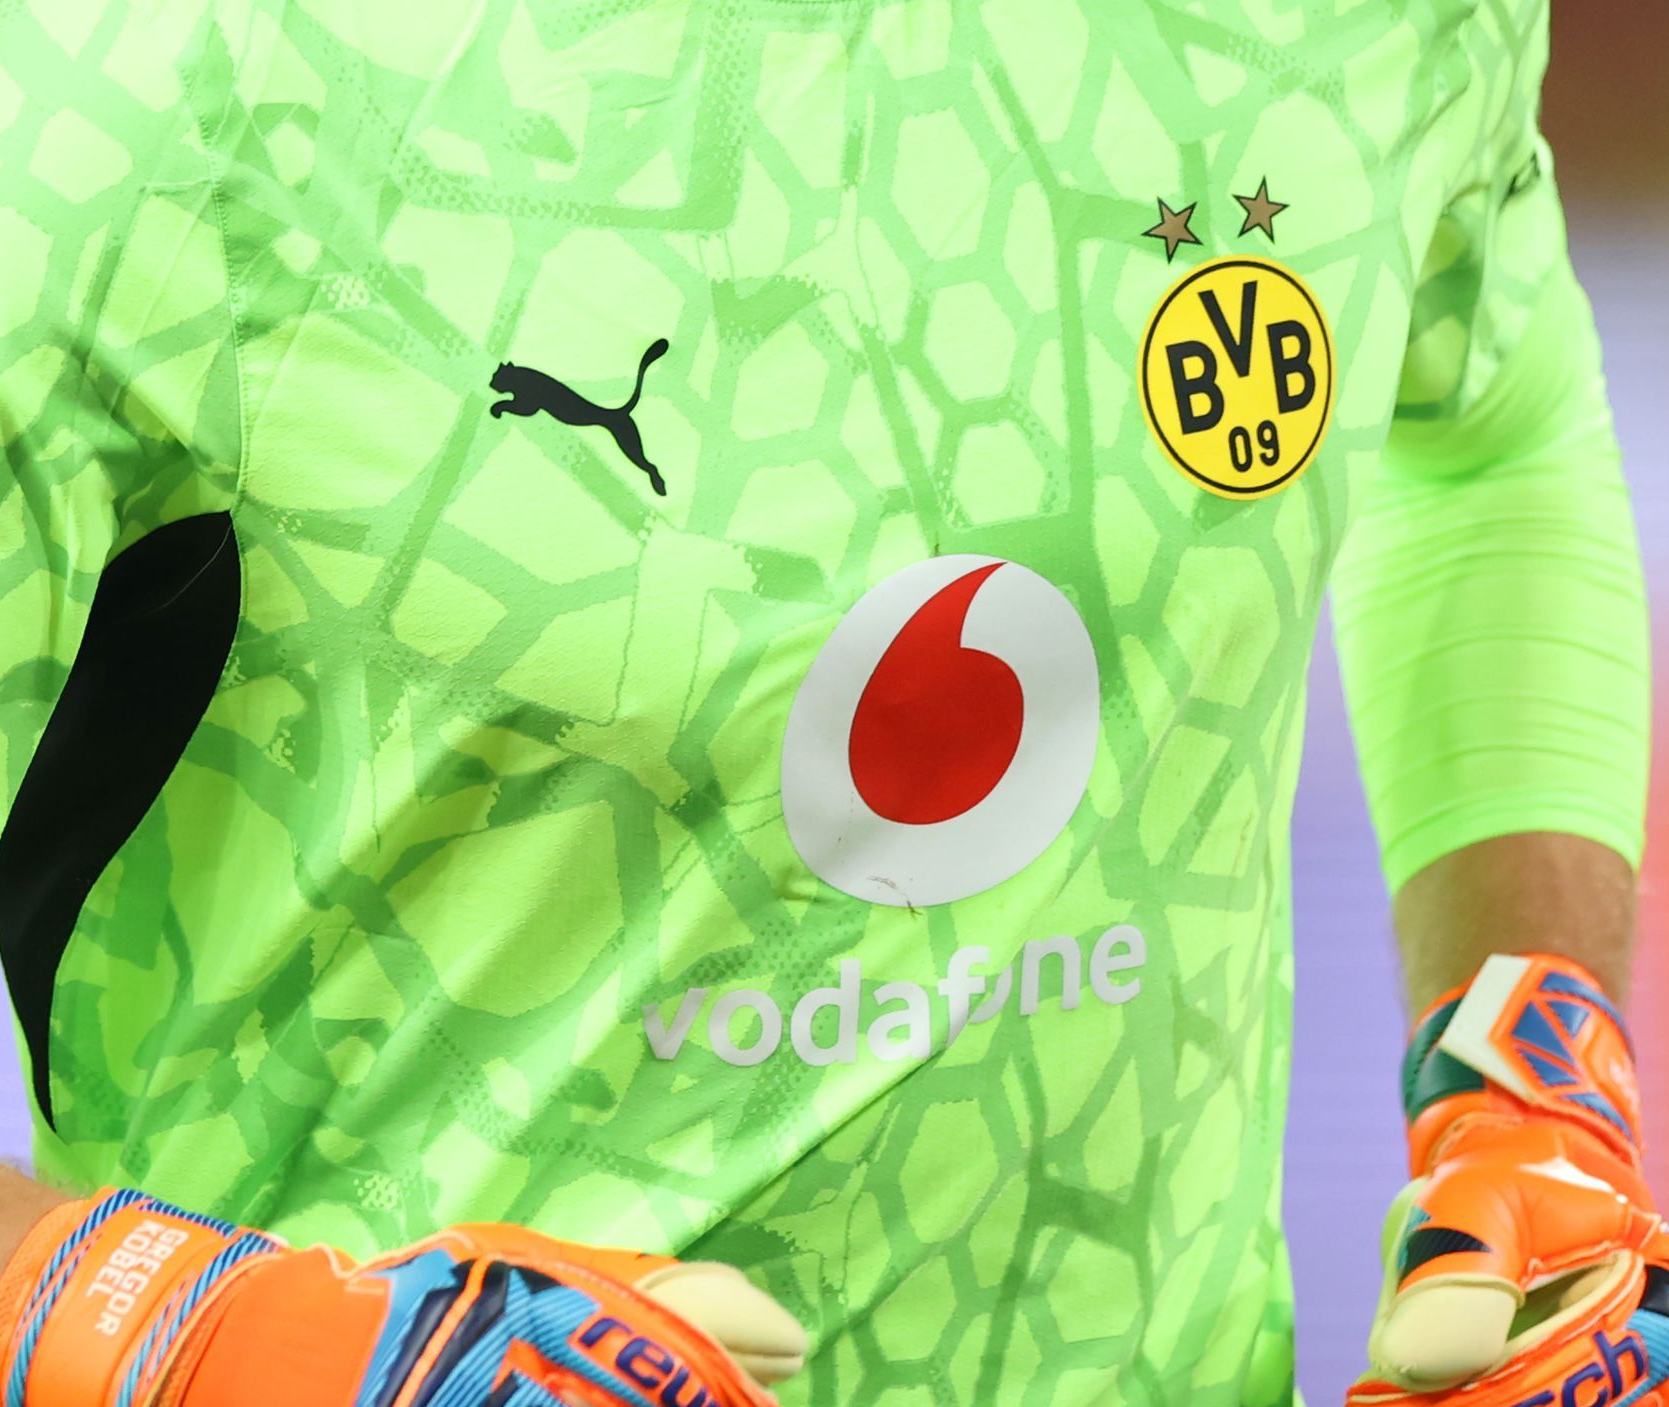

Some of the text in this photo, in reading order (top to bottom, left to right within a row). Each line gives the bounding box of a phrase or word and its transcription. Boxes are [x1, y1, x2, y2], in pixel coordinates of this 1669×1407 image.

[1165, 280, 1316, 435] BVB
[1228, 419, 1281, 472] 09
[85, 1219, 166, 1297] KOBEL
[95, 1228, 190, 1336] GREGOR
[578, 1317, 720, 1407] reu
[1510, 1330, 1644, 1407] ch
